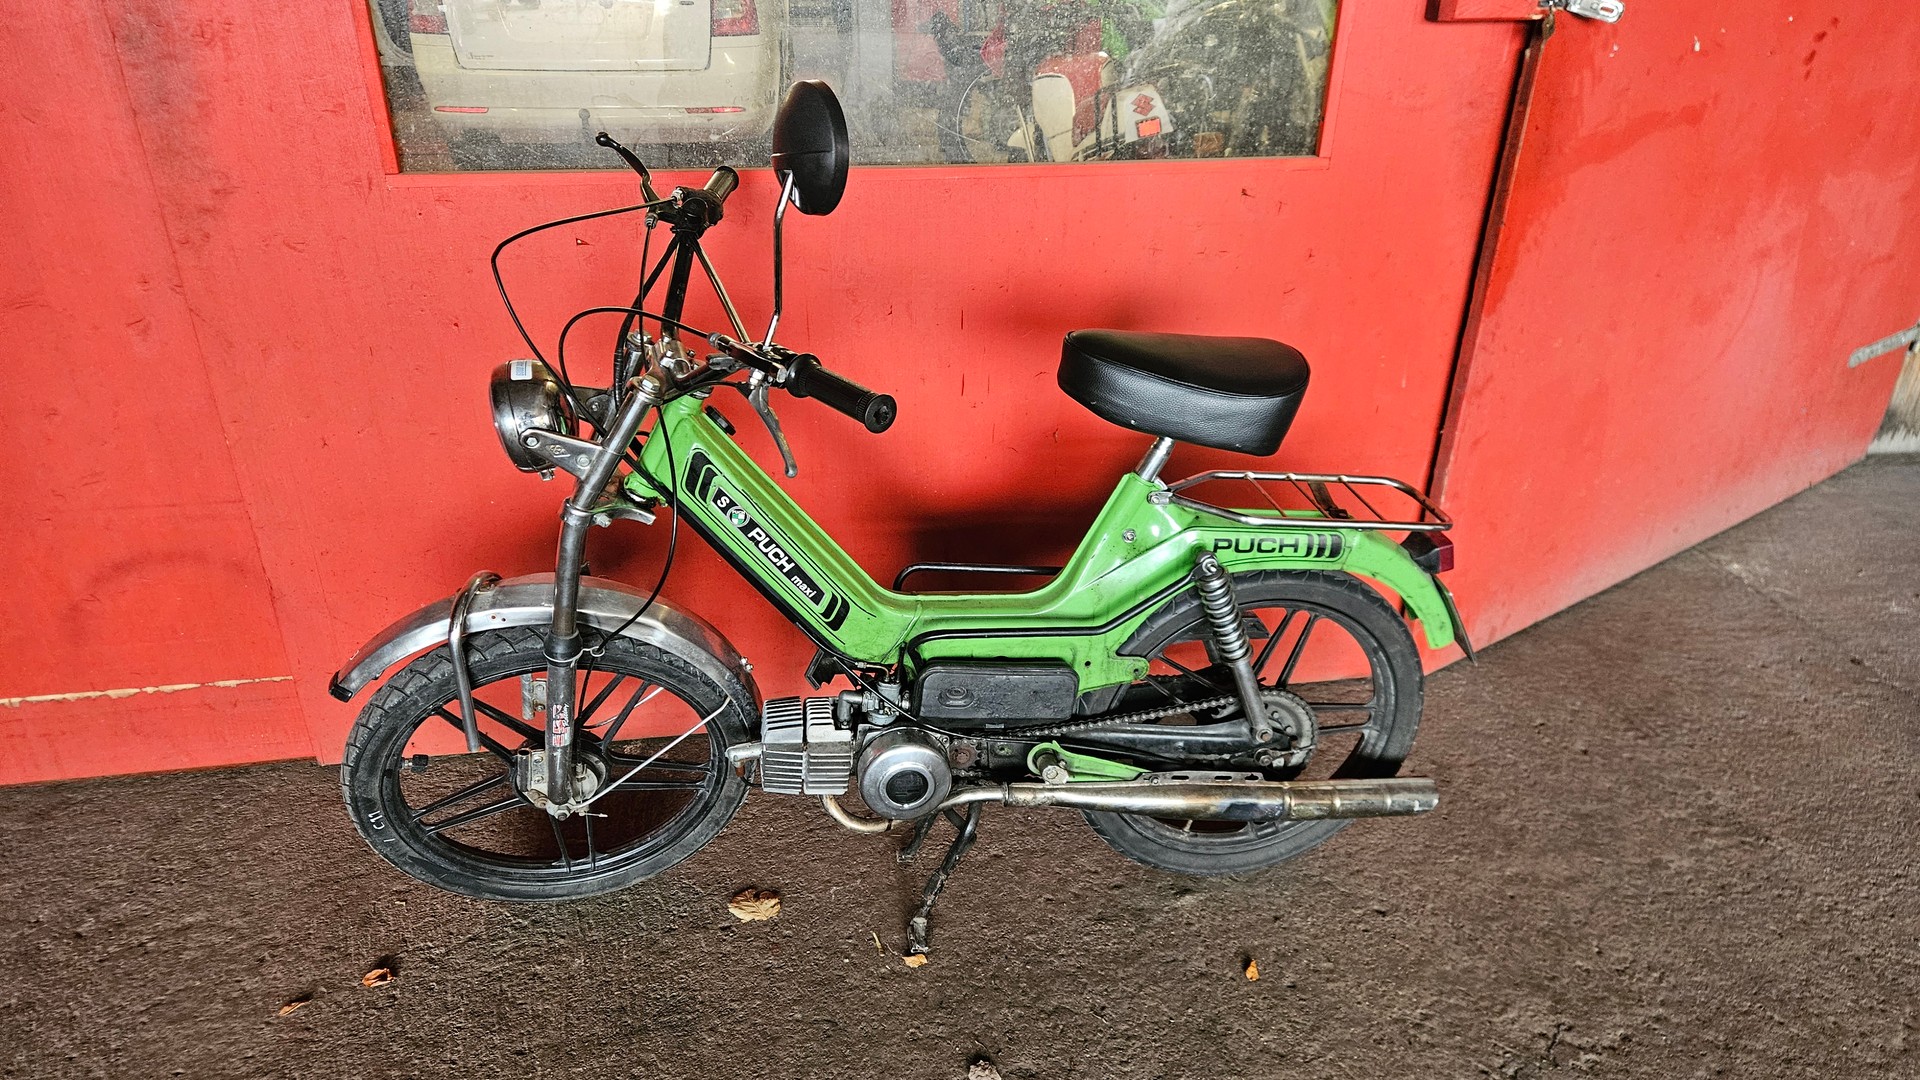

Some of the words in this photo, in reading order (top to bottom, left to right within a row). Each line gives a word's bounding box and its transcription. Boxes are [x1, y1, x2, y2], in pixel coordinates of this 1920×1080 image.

[717, 496, 730, 508] S
[748, 527, 795, 573] PUCH
[791, 575, 817, 599] maxi
[1213, 538, 1300, 554] PUCH
